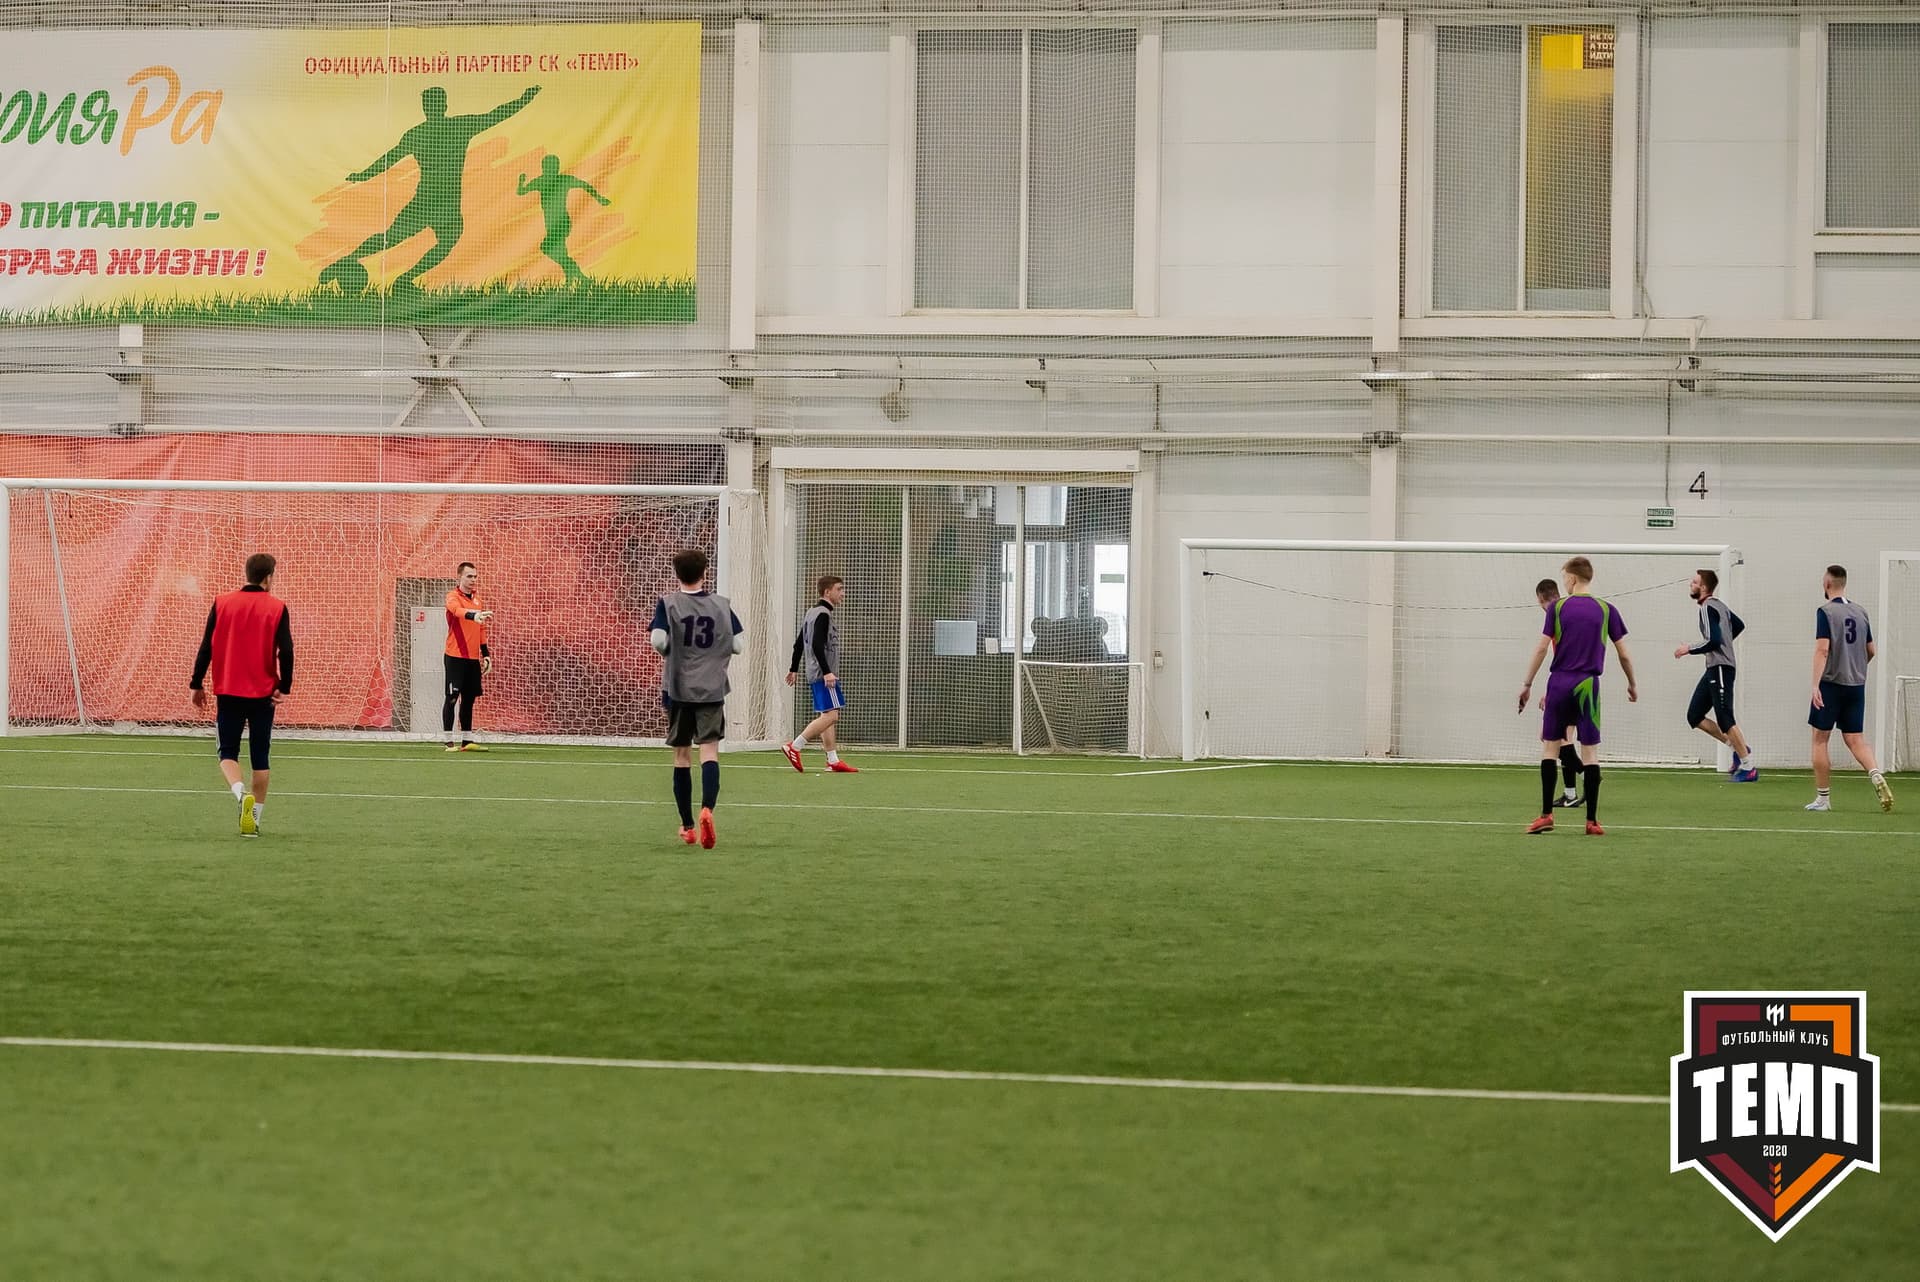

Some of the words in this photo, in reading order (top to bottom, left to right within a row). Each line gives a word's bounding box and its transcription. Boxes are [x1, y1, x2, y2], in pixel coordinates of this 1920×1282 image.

[304, 50, 451, 80] ОФИЦИАЛЬНЫЙ
[456, 54, 532, 73] ПАРТНЕР
[538, 53, 560, 72] СК
[566, 52, 639, 71] «ТЕМП»
[20, 201, 197, 228] ПИТАНИЯ
[1688, 470, 1709, 500] 4
[681, 615, 716, 649] 13
[1844, 618, 1857, 645] 3
